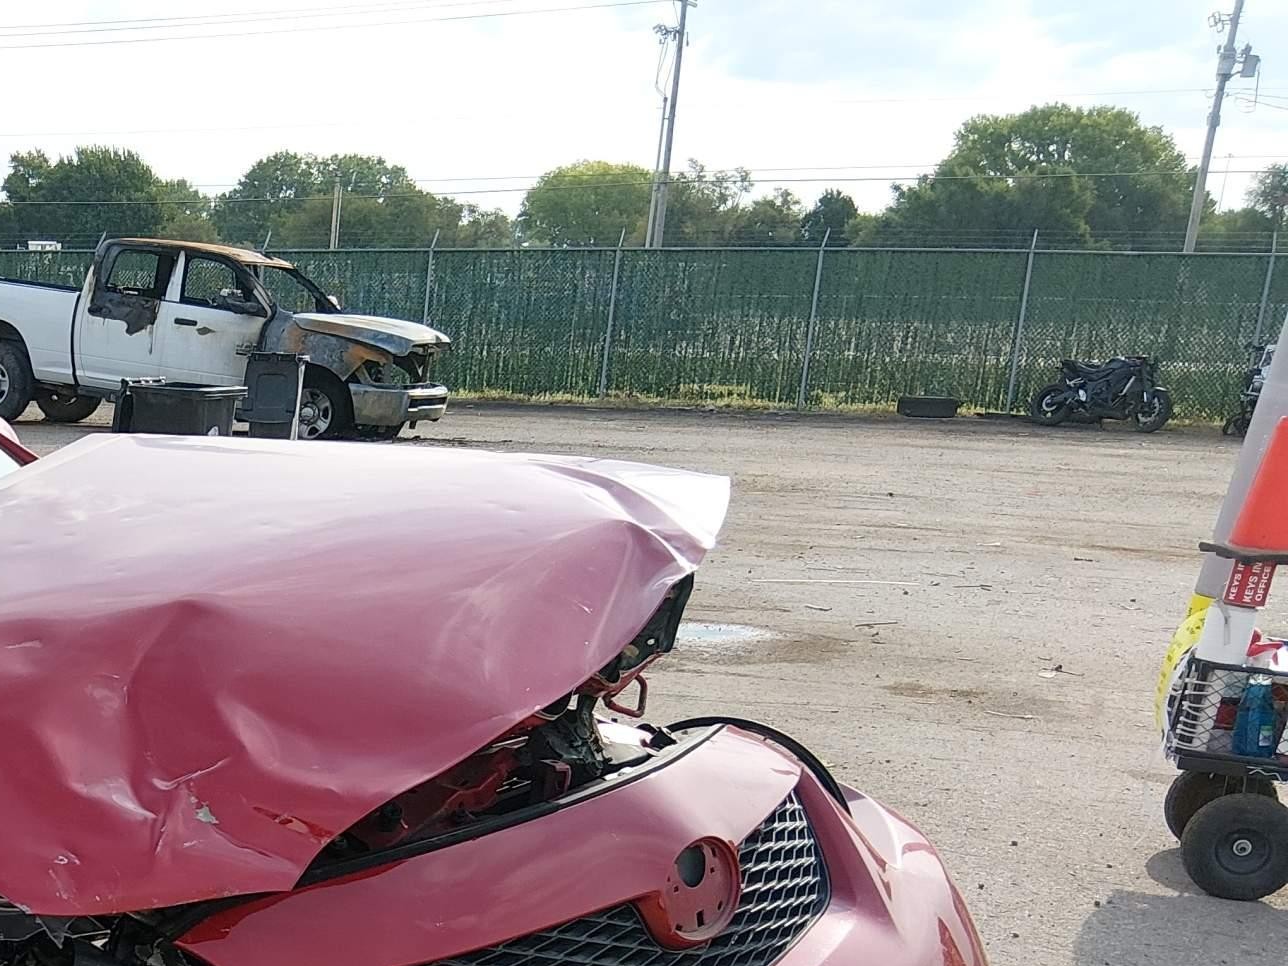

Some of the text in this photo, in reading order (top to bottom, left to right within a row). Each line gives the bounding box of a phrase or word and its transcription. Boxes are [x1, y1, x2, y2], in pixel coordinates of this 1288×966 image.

[1228, 573, 1242, 600] KEYS
[1242, 562, 1263, 603] KEYS IN
[1255, 566, 1273, 602] OFFICE
